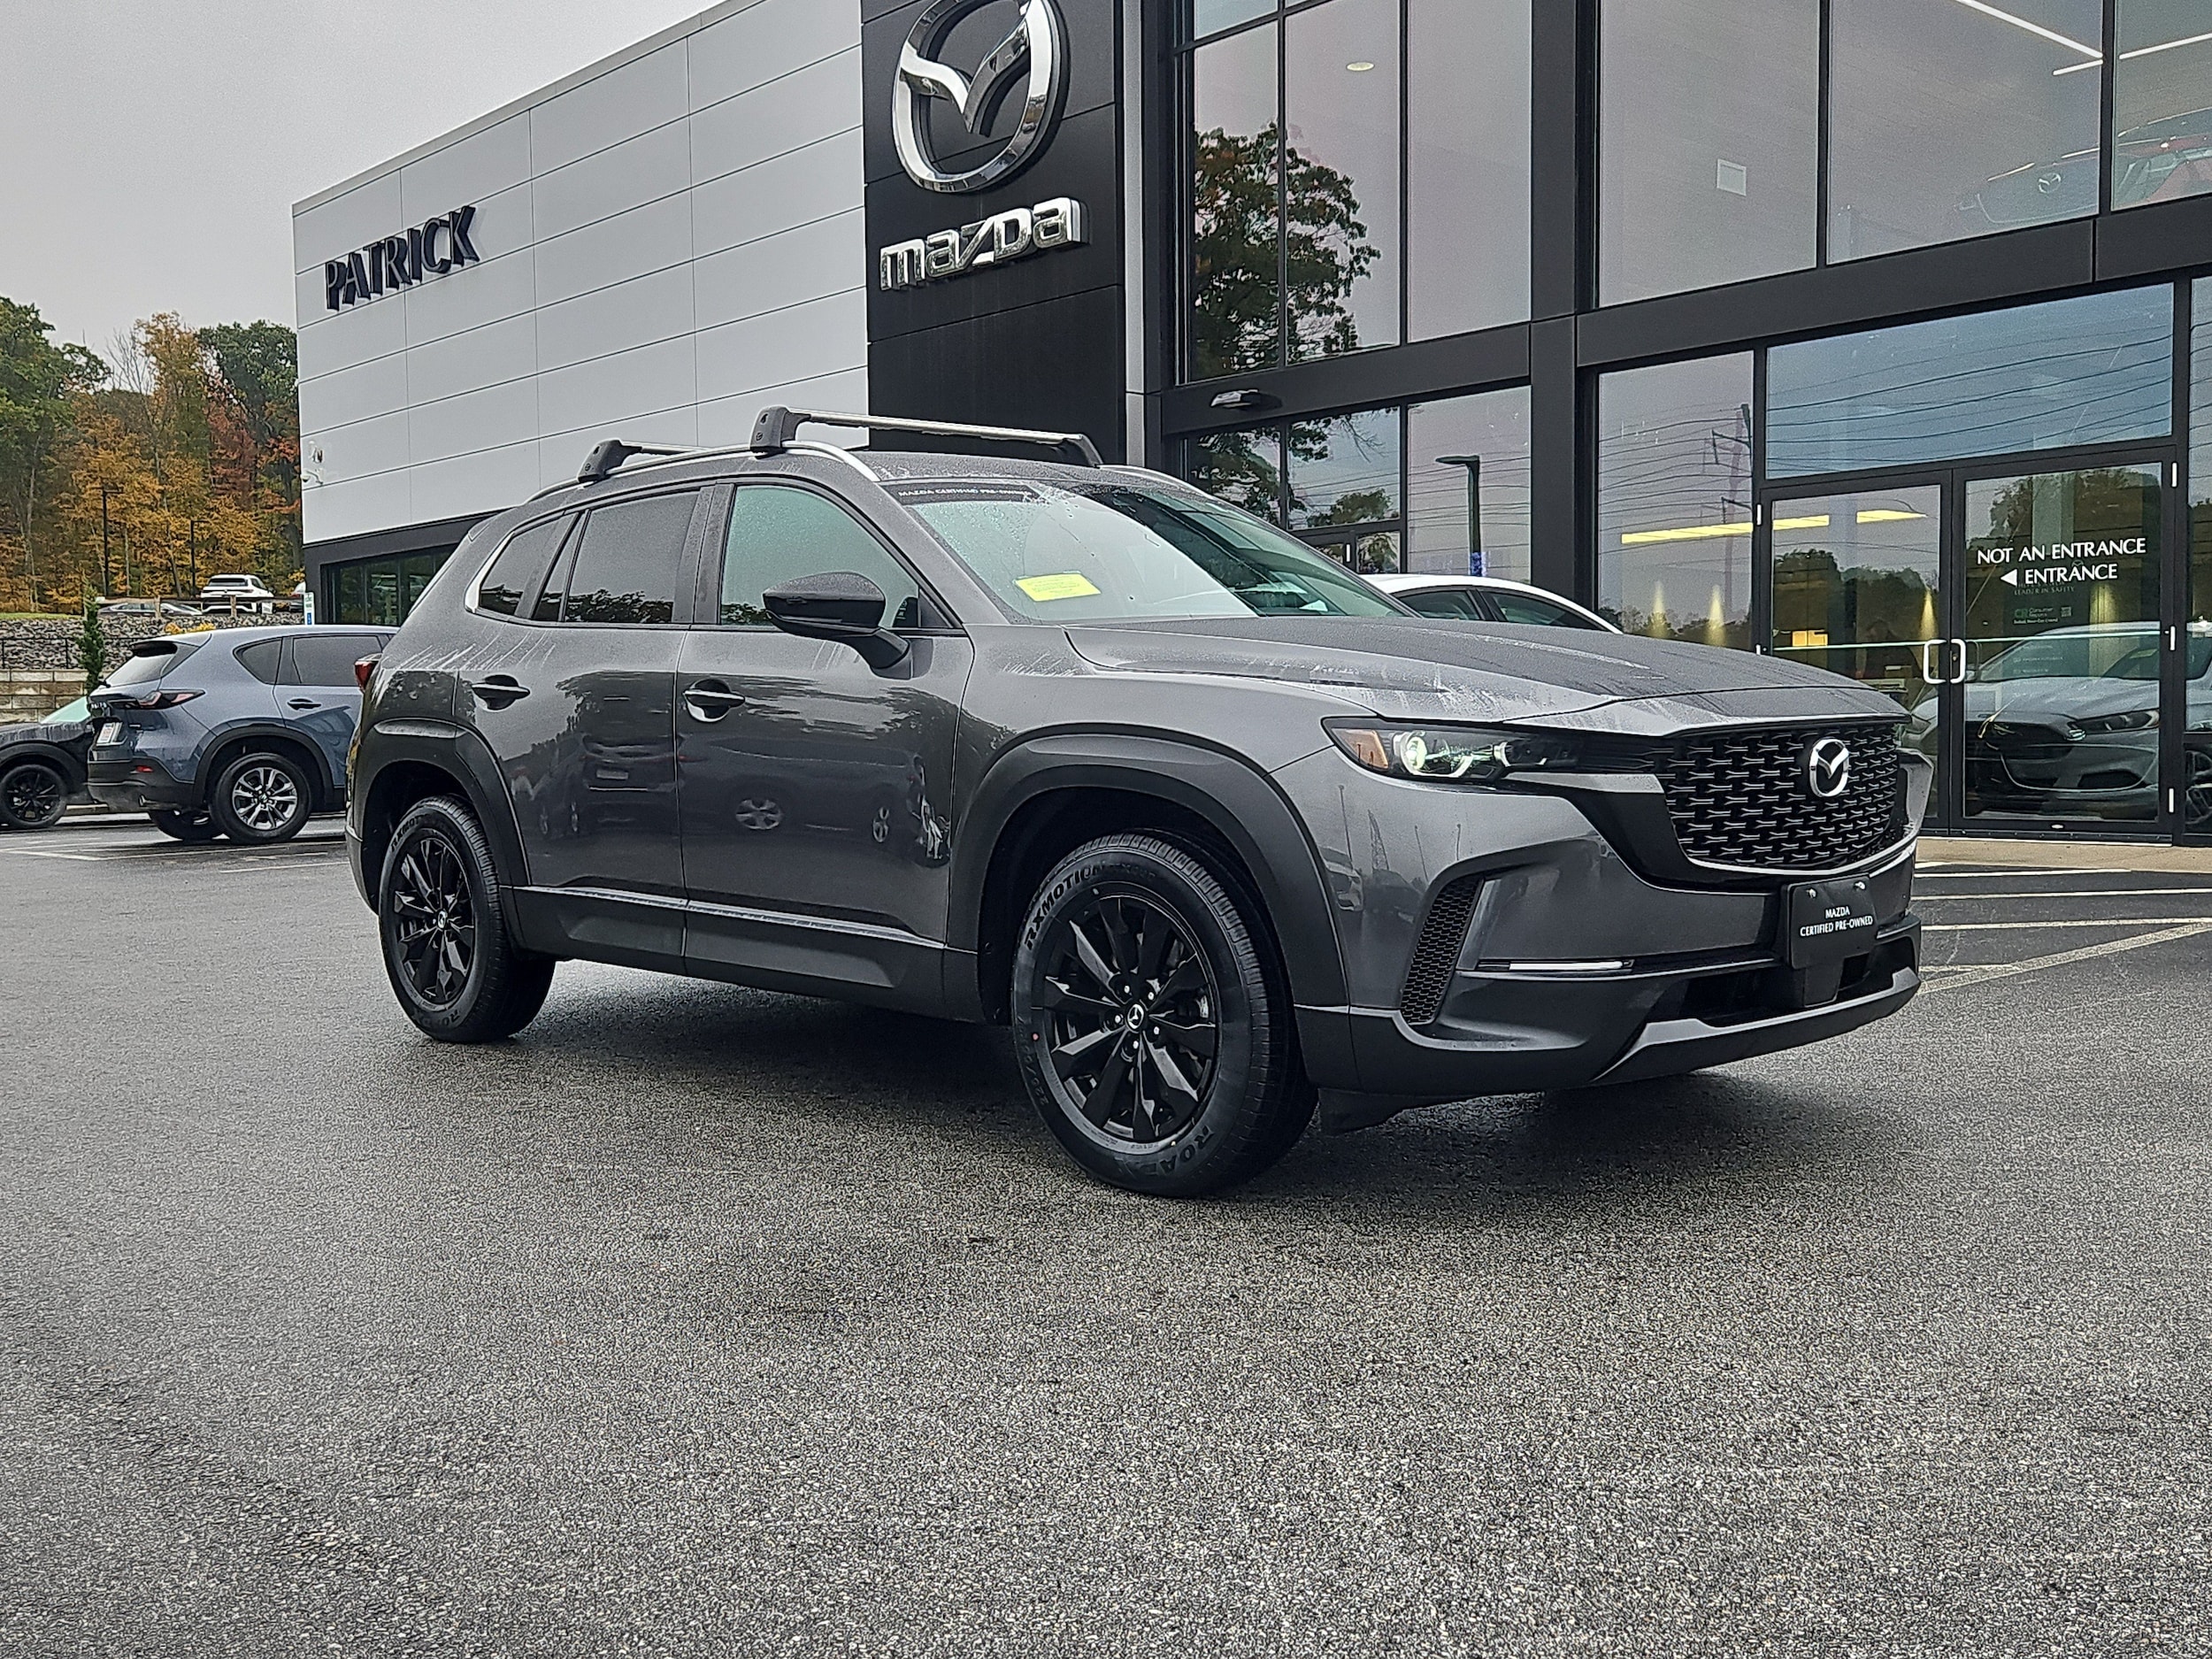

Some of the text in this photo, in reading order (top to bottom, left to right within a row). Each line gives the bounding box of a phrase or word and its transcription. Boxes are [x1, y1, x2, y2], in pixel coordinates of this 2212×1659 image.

[325, 204, 480, 311] PATRICK
[1977, 537, 2147, 565] NOT AN ENTRANCE
[2024, 564, 2118, 584] ENTRANCE
[1825, 906, 1850, 918] MAZDA
[1800, 916, 1873, 937] CERTIFIED PRE-OWNED
